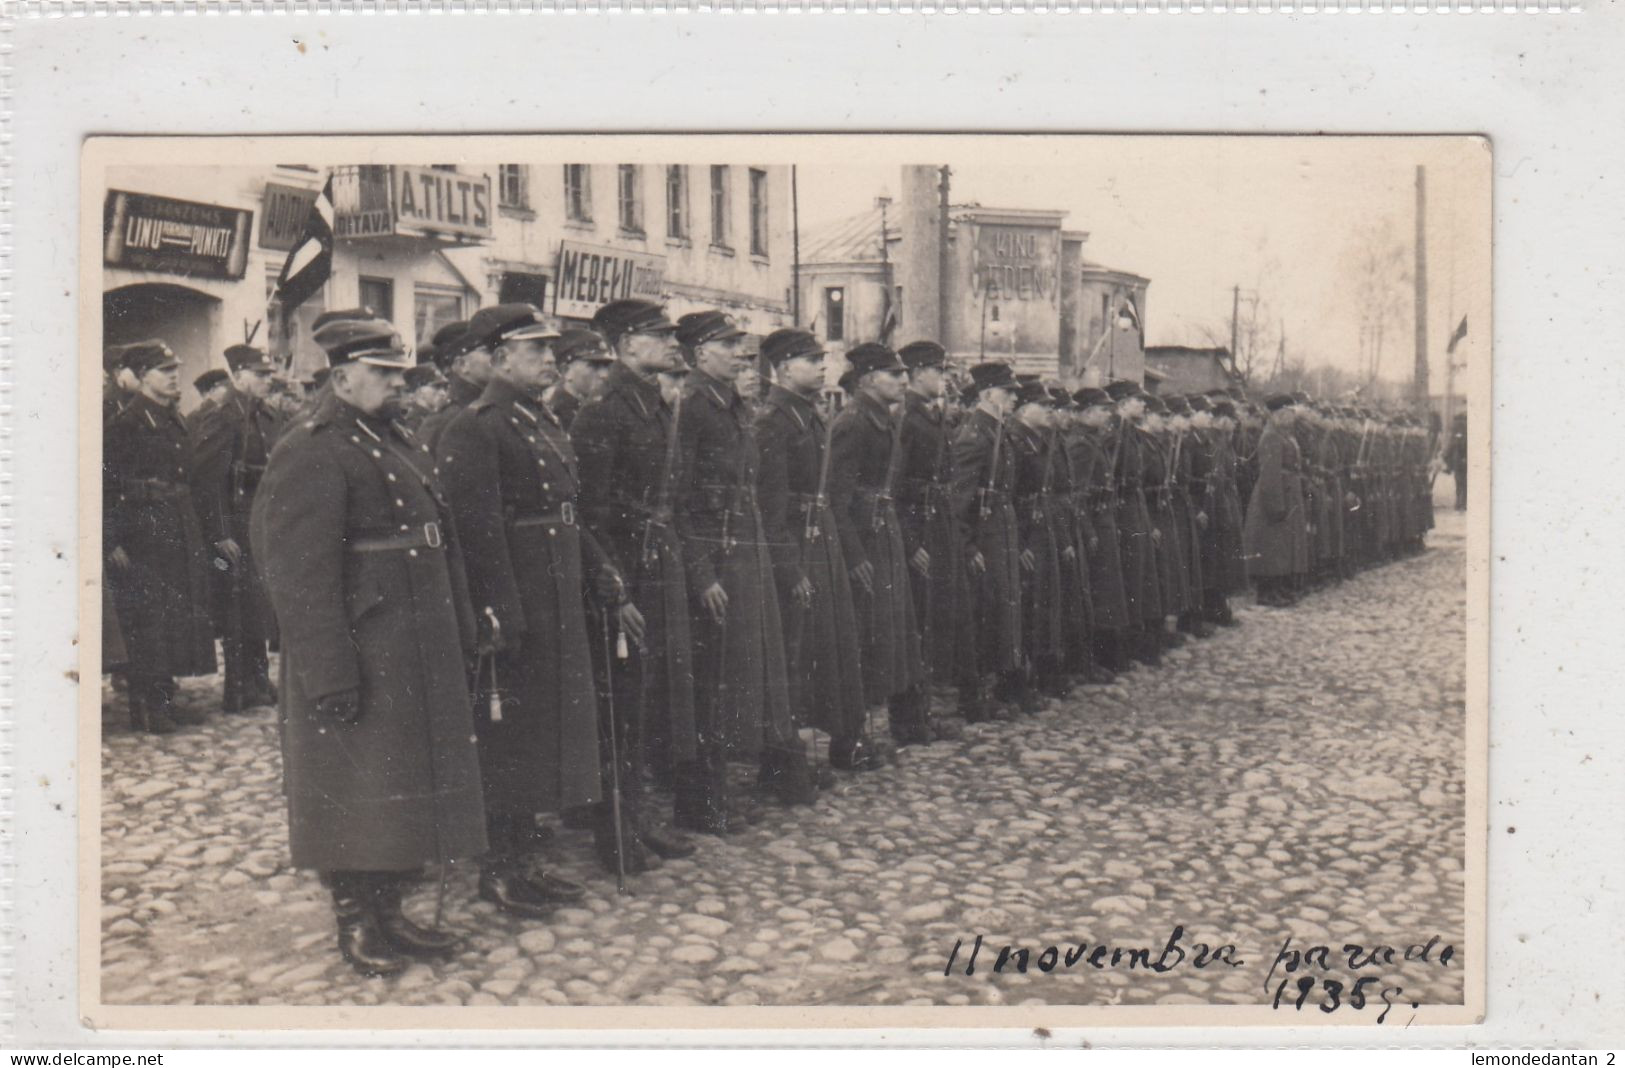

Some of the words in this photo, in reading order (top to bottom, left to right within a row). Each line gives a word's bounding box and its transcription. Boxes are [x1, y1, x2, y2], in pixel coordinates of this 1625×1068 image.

[401, 170, 488, 228] A.TILTS
[126, 215, 163, 250] LINU
[995, 231, 1037, 258] KINO
[987, 263, 1050, 301] EDEN
